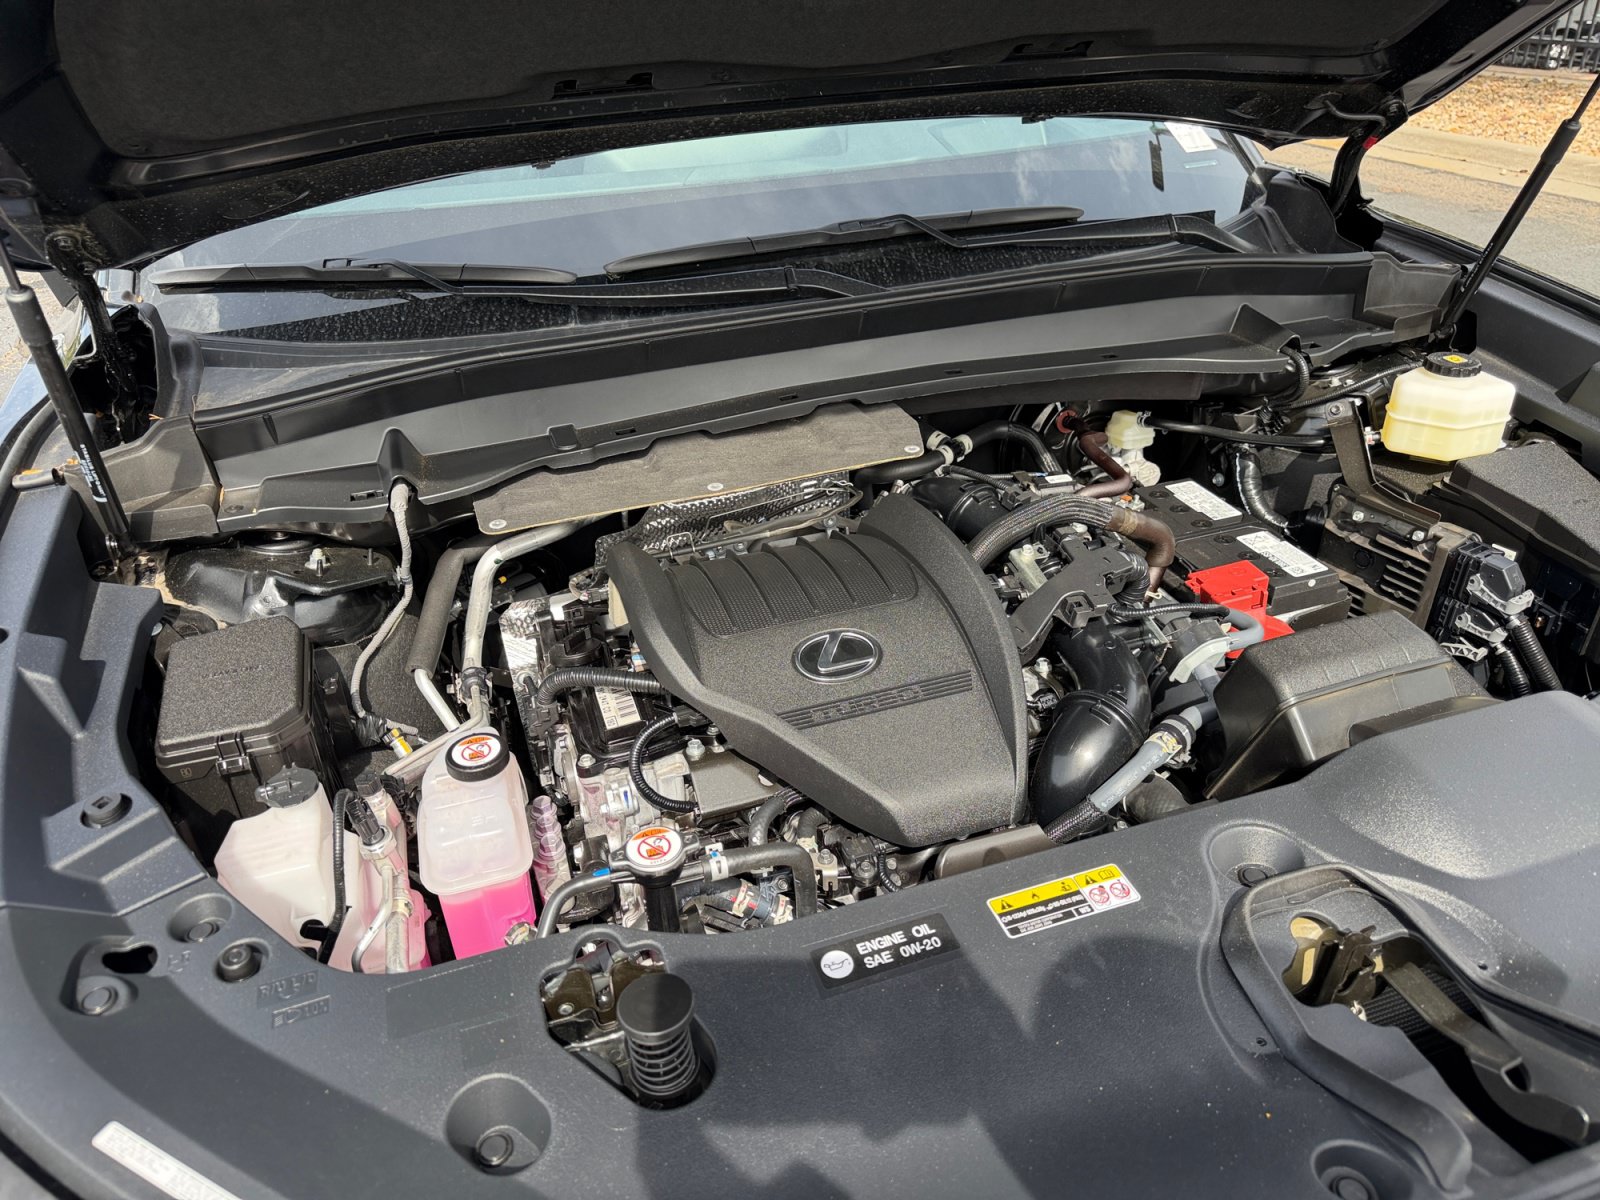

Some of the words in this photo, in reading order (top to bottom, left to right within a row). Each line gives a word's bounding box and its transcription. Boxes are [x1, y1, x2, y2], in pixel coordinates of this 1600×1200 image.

[856, 930, 907, 955] ENGINE
[911, 923, 937, 938] OIL
[863, 950, 895, 969] SAE
[899, 936, 941, 958] 0W-20
